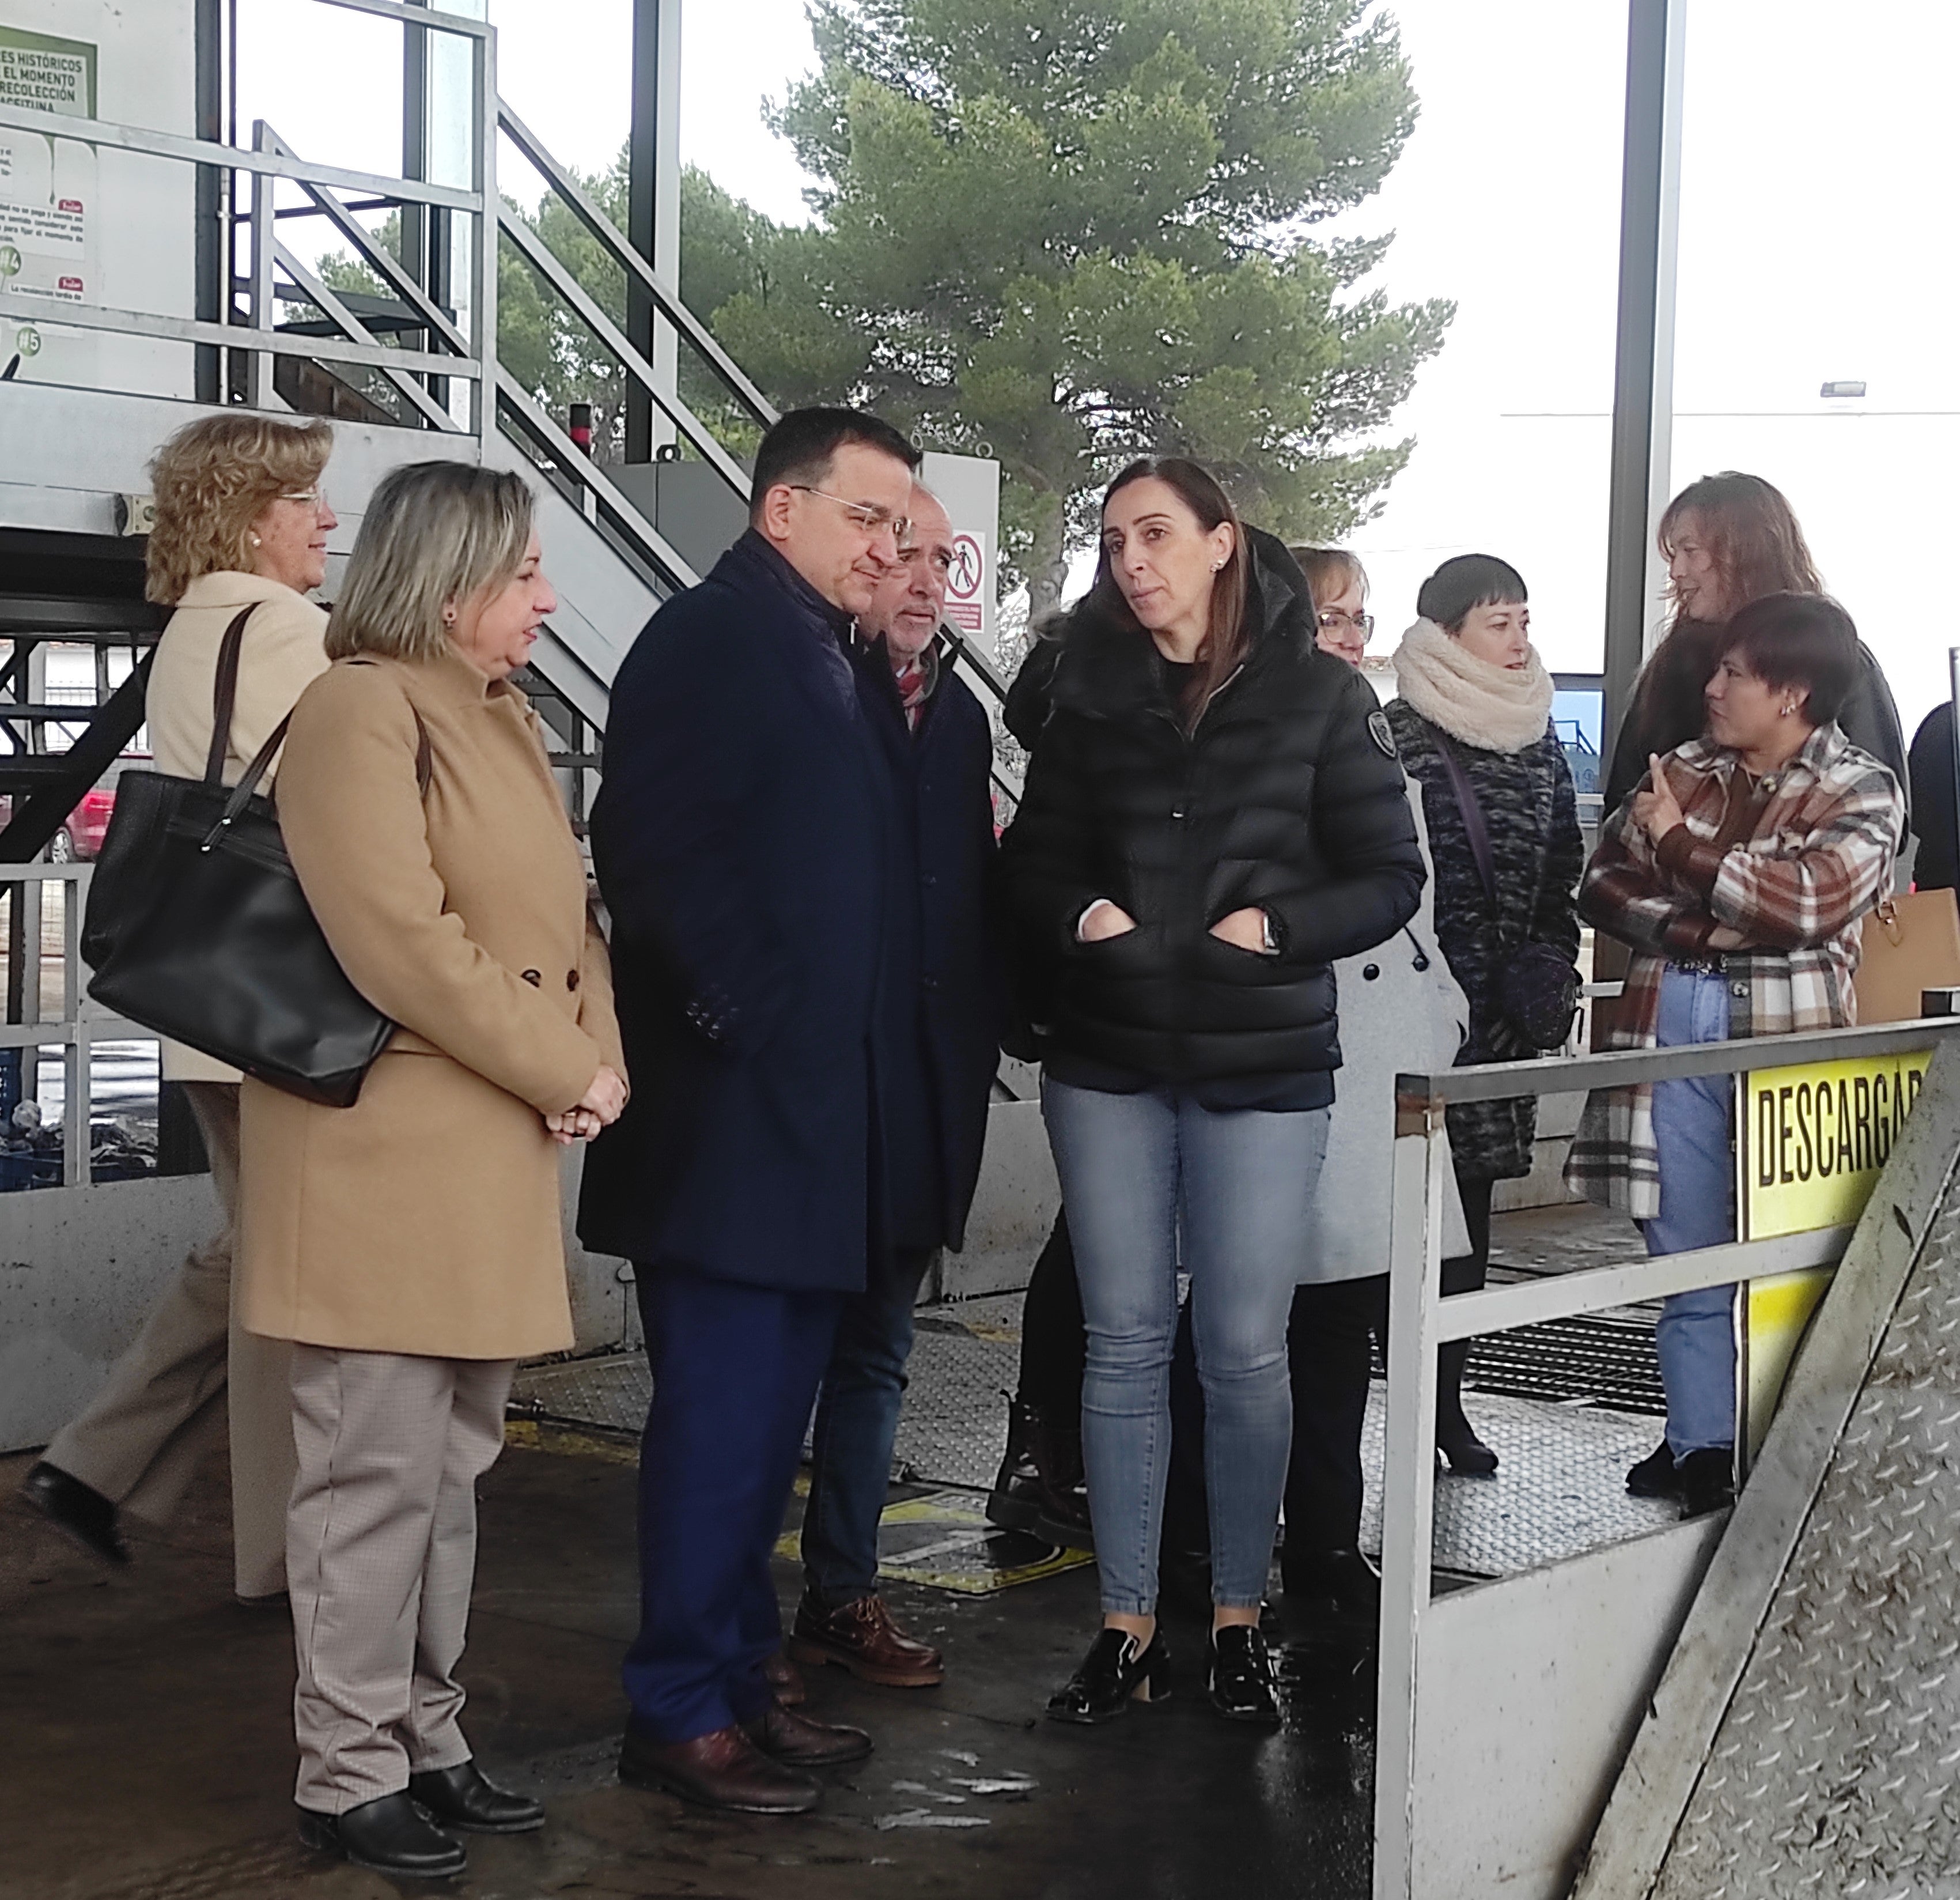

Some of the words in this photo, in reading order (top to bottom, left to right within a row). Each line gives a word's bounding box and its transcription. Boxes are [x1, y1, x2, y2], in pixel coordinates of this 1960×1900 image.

[17, 52, 82, 73] HISTÓRICOS
[4, 66, 17, 80] EL
[20, 69, 75, 86] MOMENTO
[0, 81, 75, 102] RECOLECCIÓN
